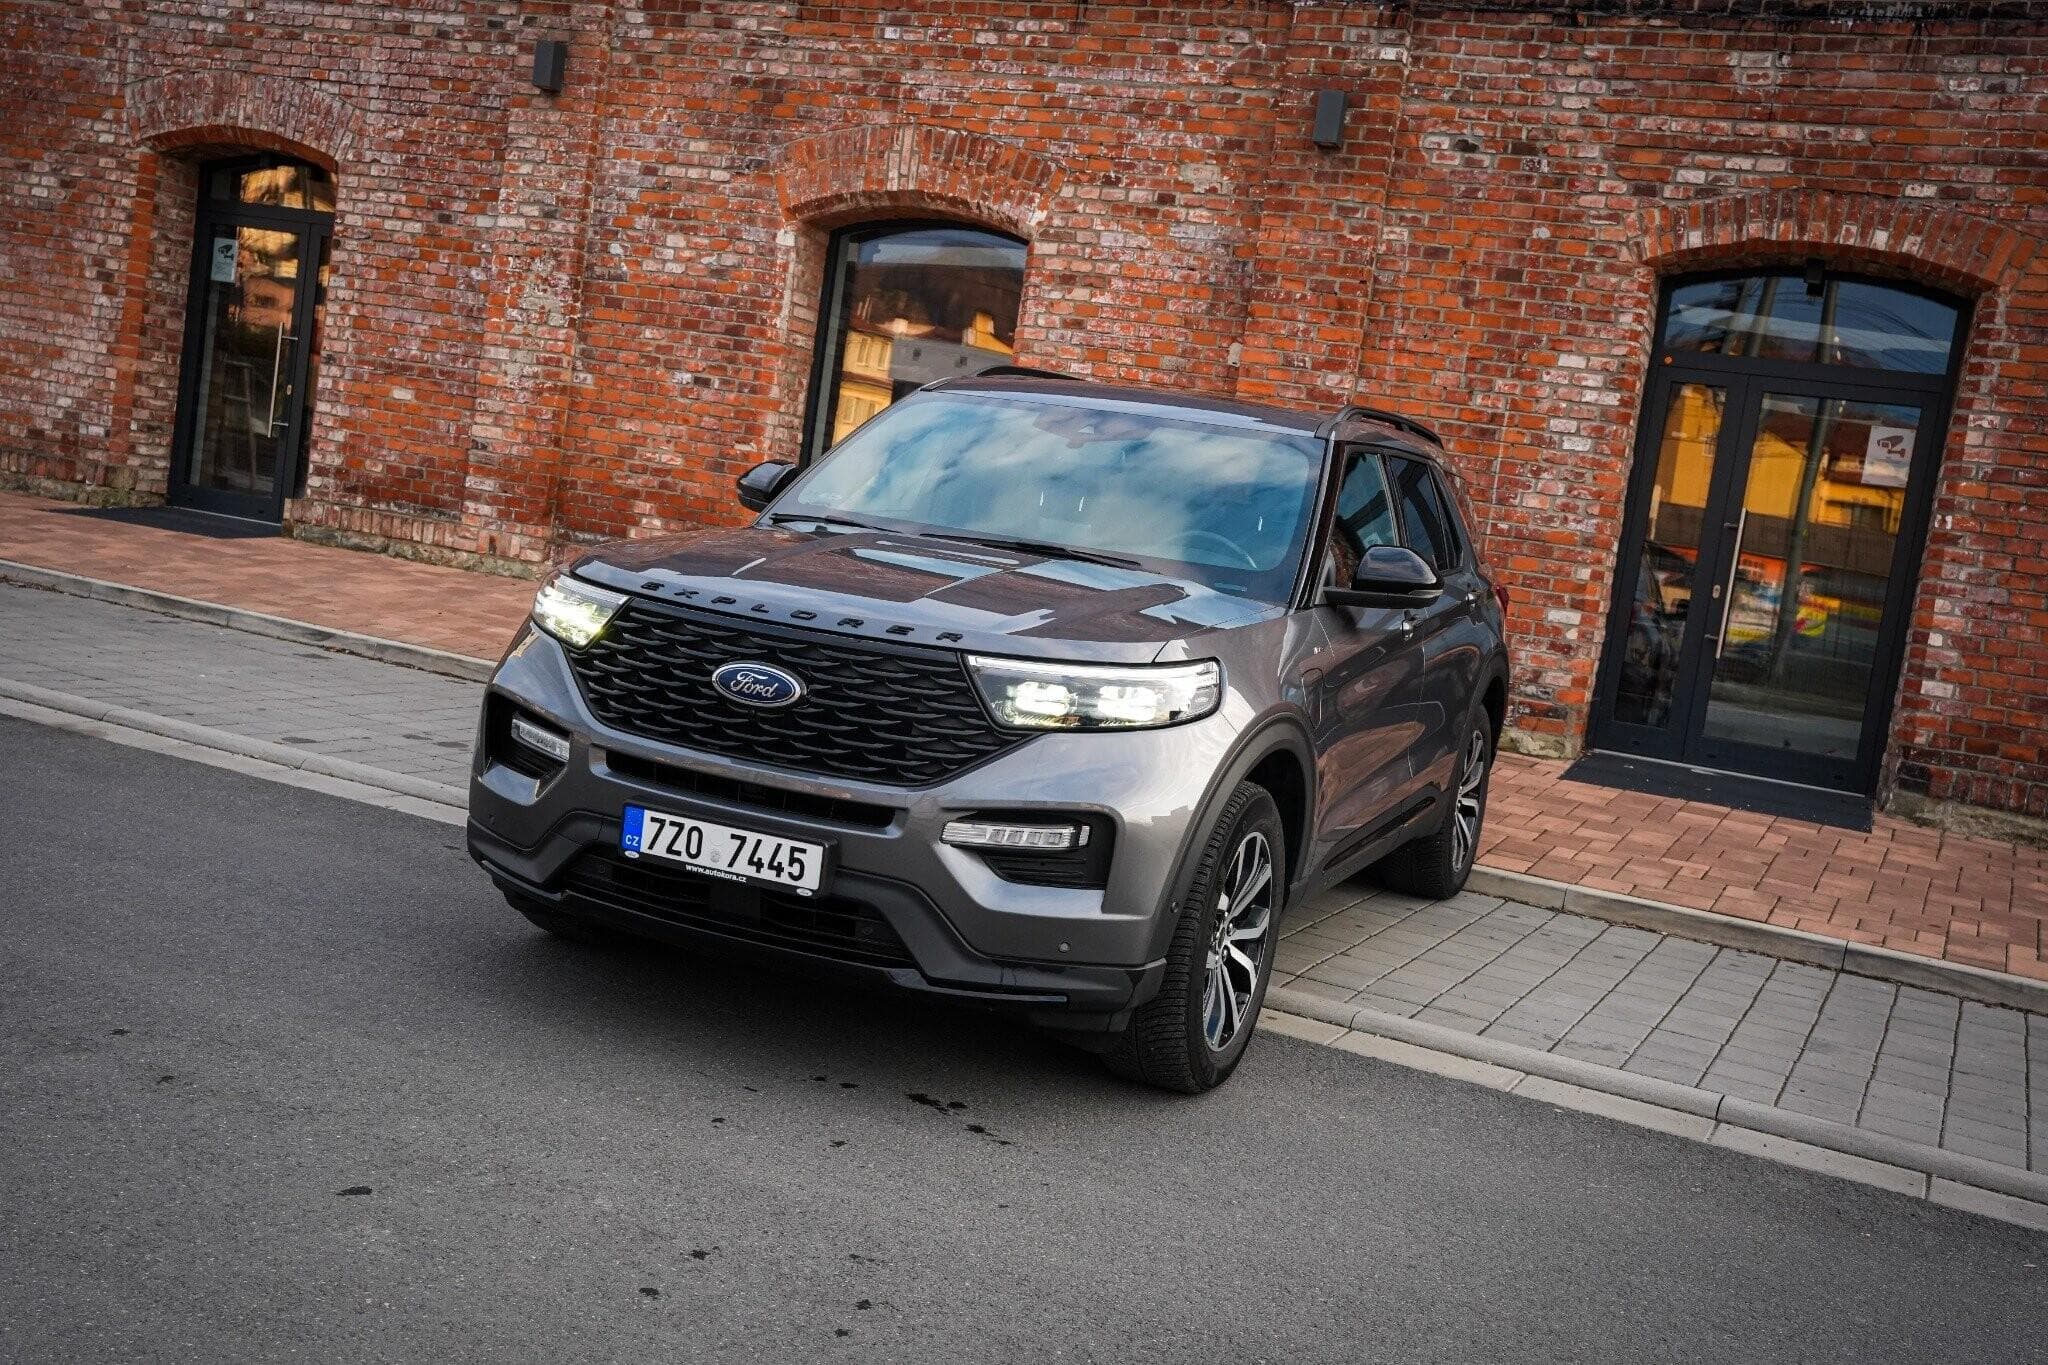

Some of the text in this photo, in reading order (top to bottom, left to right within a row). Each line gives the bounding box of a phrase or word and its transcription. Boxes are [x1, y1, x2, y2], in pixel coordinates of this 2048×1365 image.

[641, 581, 963, 642] EXPLORER
[730, 671, 778, 698] Ford
[625, 834, 640, 847] CZ
[647, 816, 807, 882] 7Z0 7445
